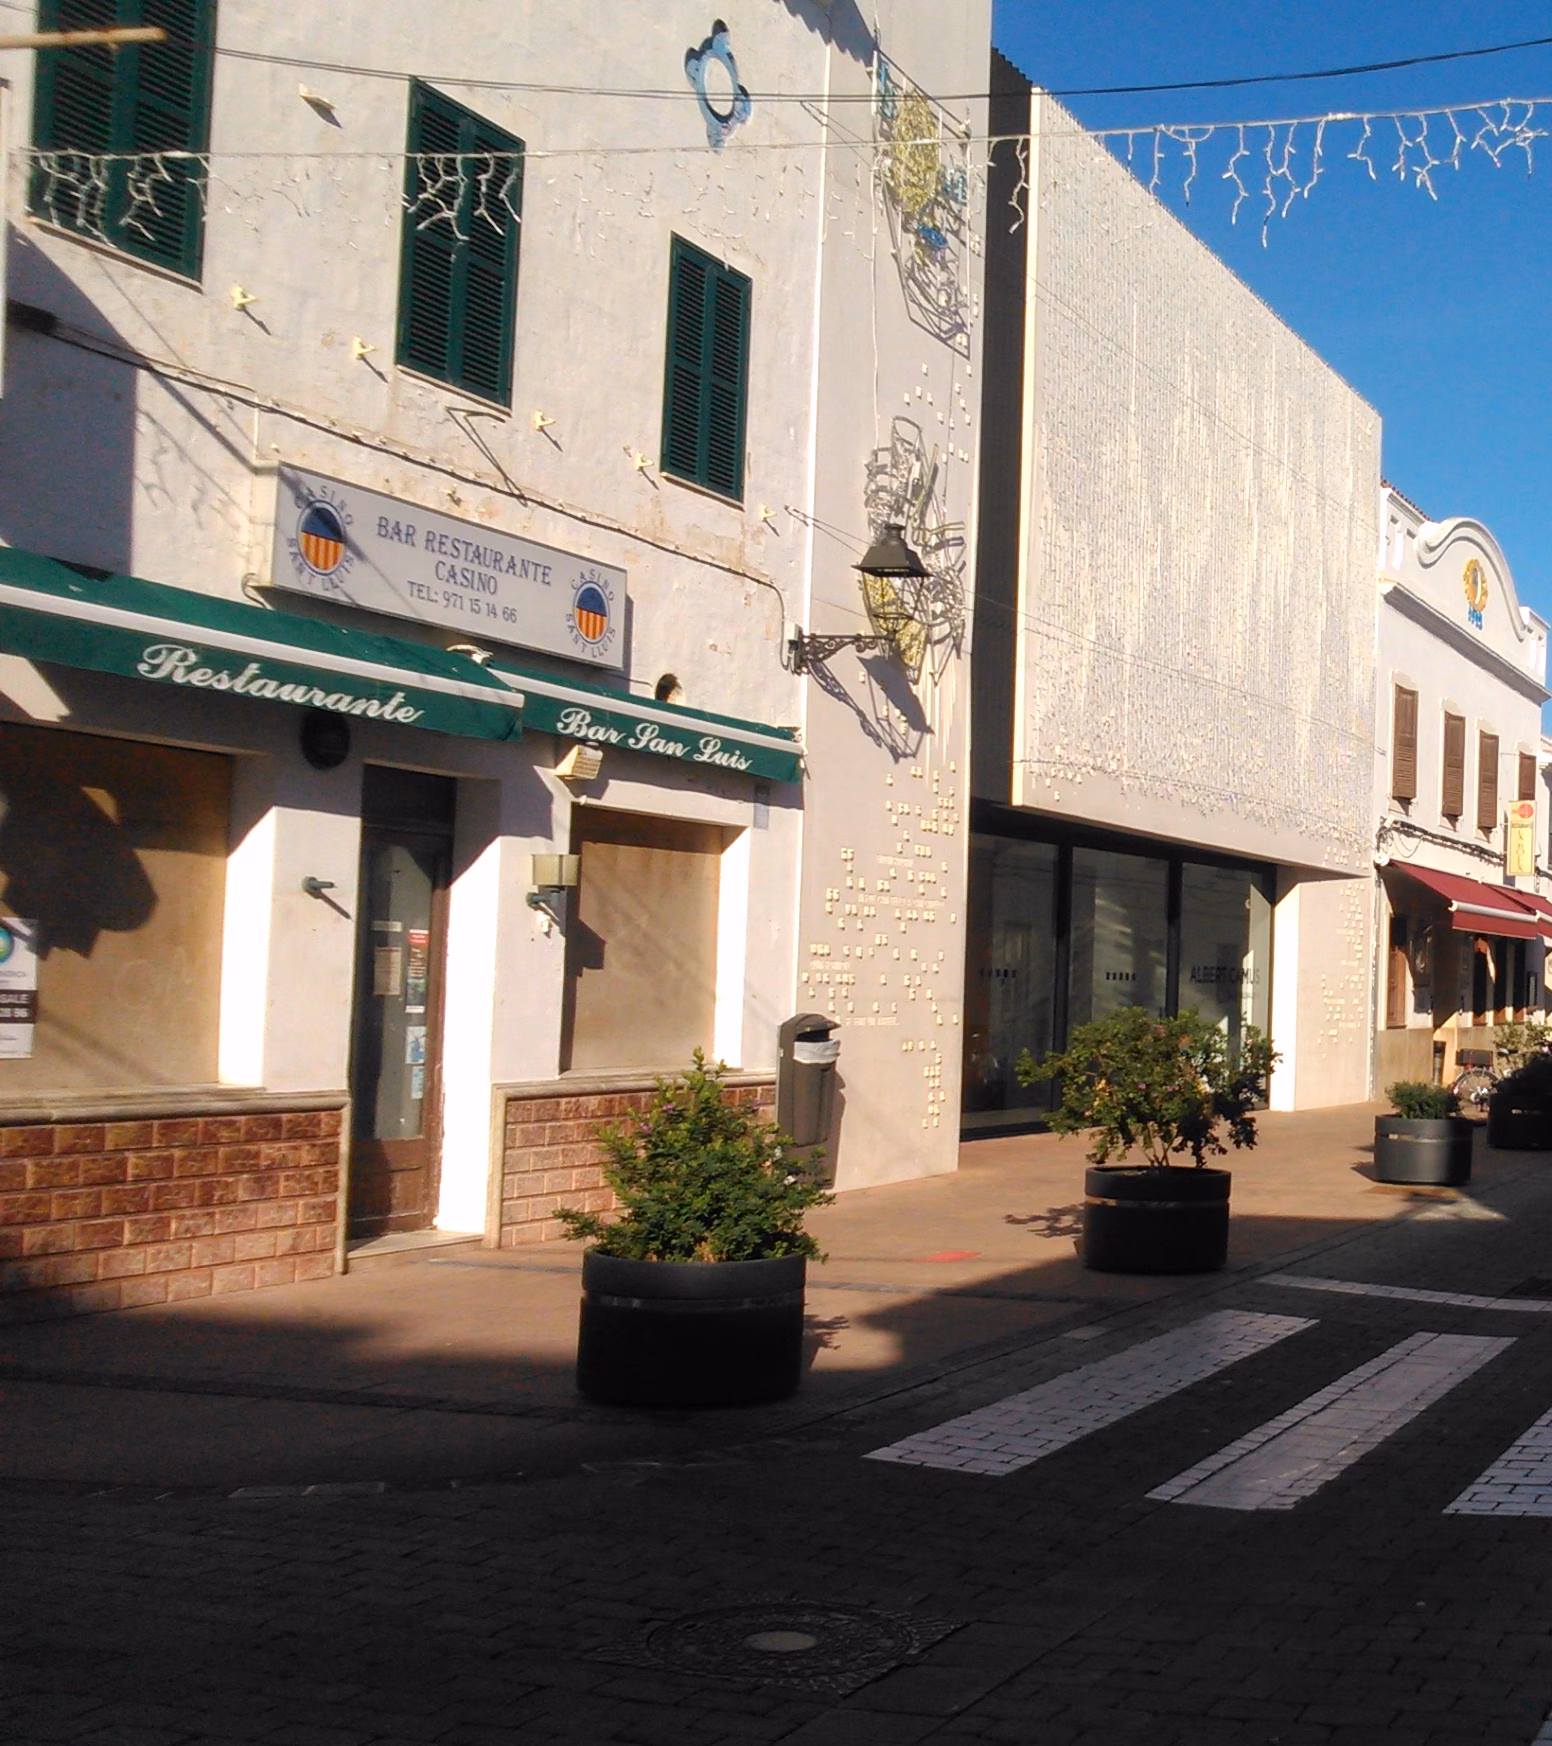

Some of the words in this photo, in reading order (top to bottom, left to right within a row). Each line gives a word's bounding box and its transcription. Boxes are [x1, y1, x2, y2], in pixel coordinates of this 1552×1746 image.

[294, 485, 355, 526] CASINO
[286, 536, 317, 586] SANT
[376, 516, 417, 547] BAR
[424, 530, 553, 587] RESTAURANTE
[434, 560, 498, 596] CASINO
[570, 568, 615, 602] CASINO
[407, 580, 439, 604] TEL:
[442, 589, 464, 611] 971
[469, 598, 482, 615] 15
[485, 602, 498, 619] 14
[502, 607, 518, 624] 66
[565, 613, 587, 654] SANT
[136, 643, 426, 724] Restaurante
[556, 706, 627, 744] Bar
[627, 721, 692, 758] San
[692, 735, 754, 772] Luis
[1190, 965, 1228, 984] ALBERT
[1229, 966, 1261, 985] CAMUS
